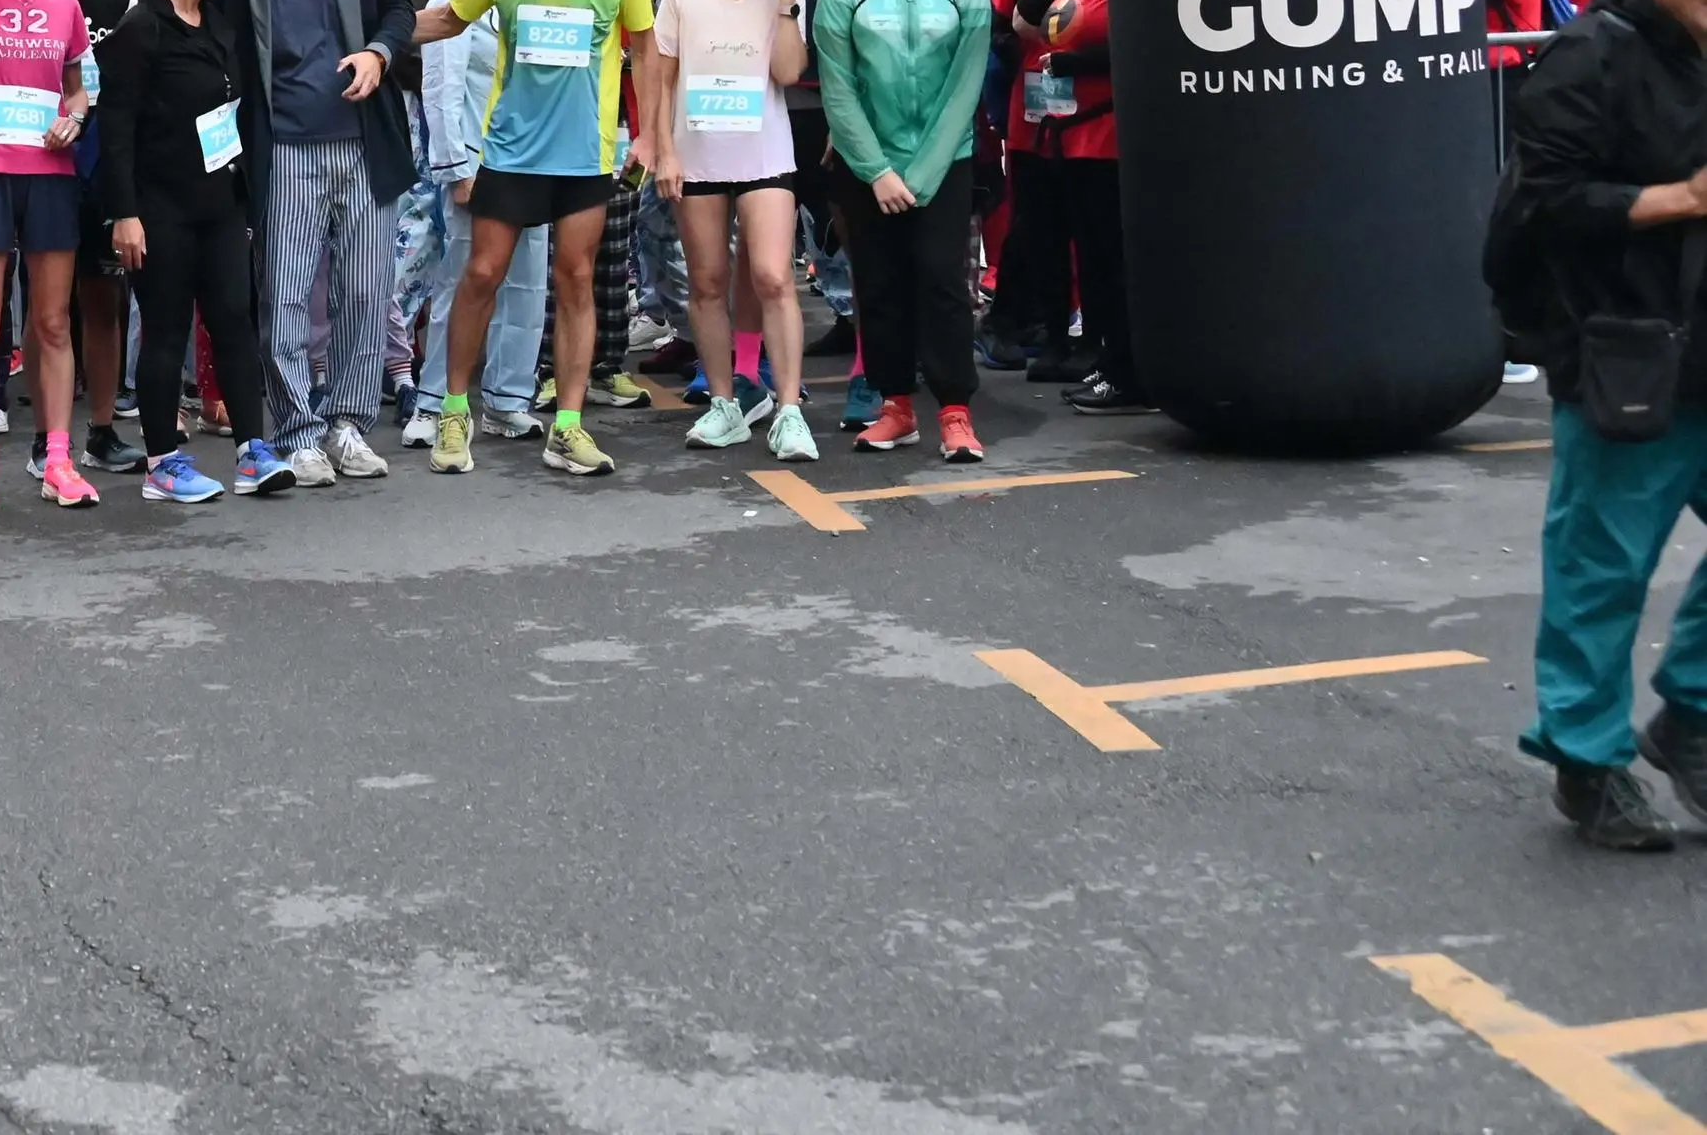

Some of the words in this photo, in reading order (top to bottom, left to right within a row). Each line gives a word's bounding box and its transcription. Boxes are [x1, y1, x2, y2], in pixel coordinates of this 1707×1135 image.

[0, 8, 50, 33] 32
[528, 26, 579, 46] 8226
[1180, 62, 1366, 94] RUNNING
[1382, 59, 1404, 83] &
[1418, 47, 1487, 79] TRAIL
[699, 94, 749, 111] 7728
[3, 107, 46, 128] 7681
